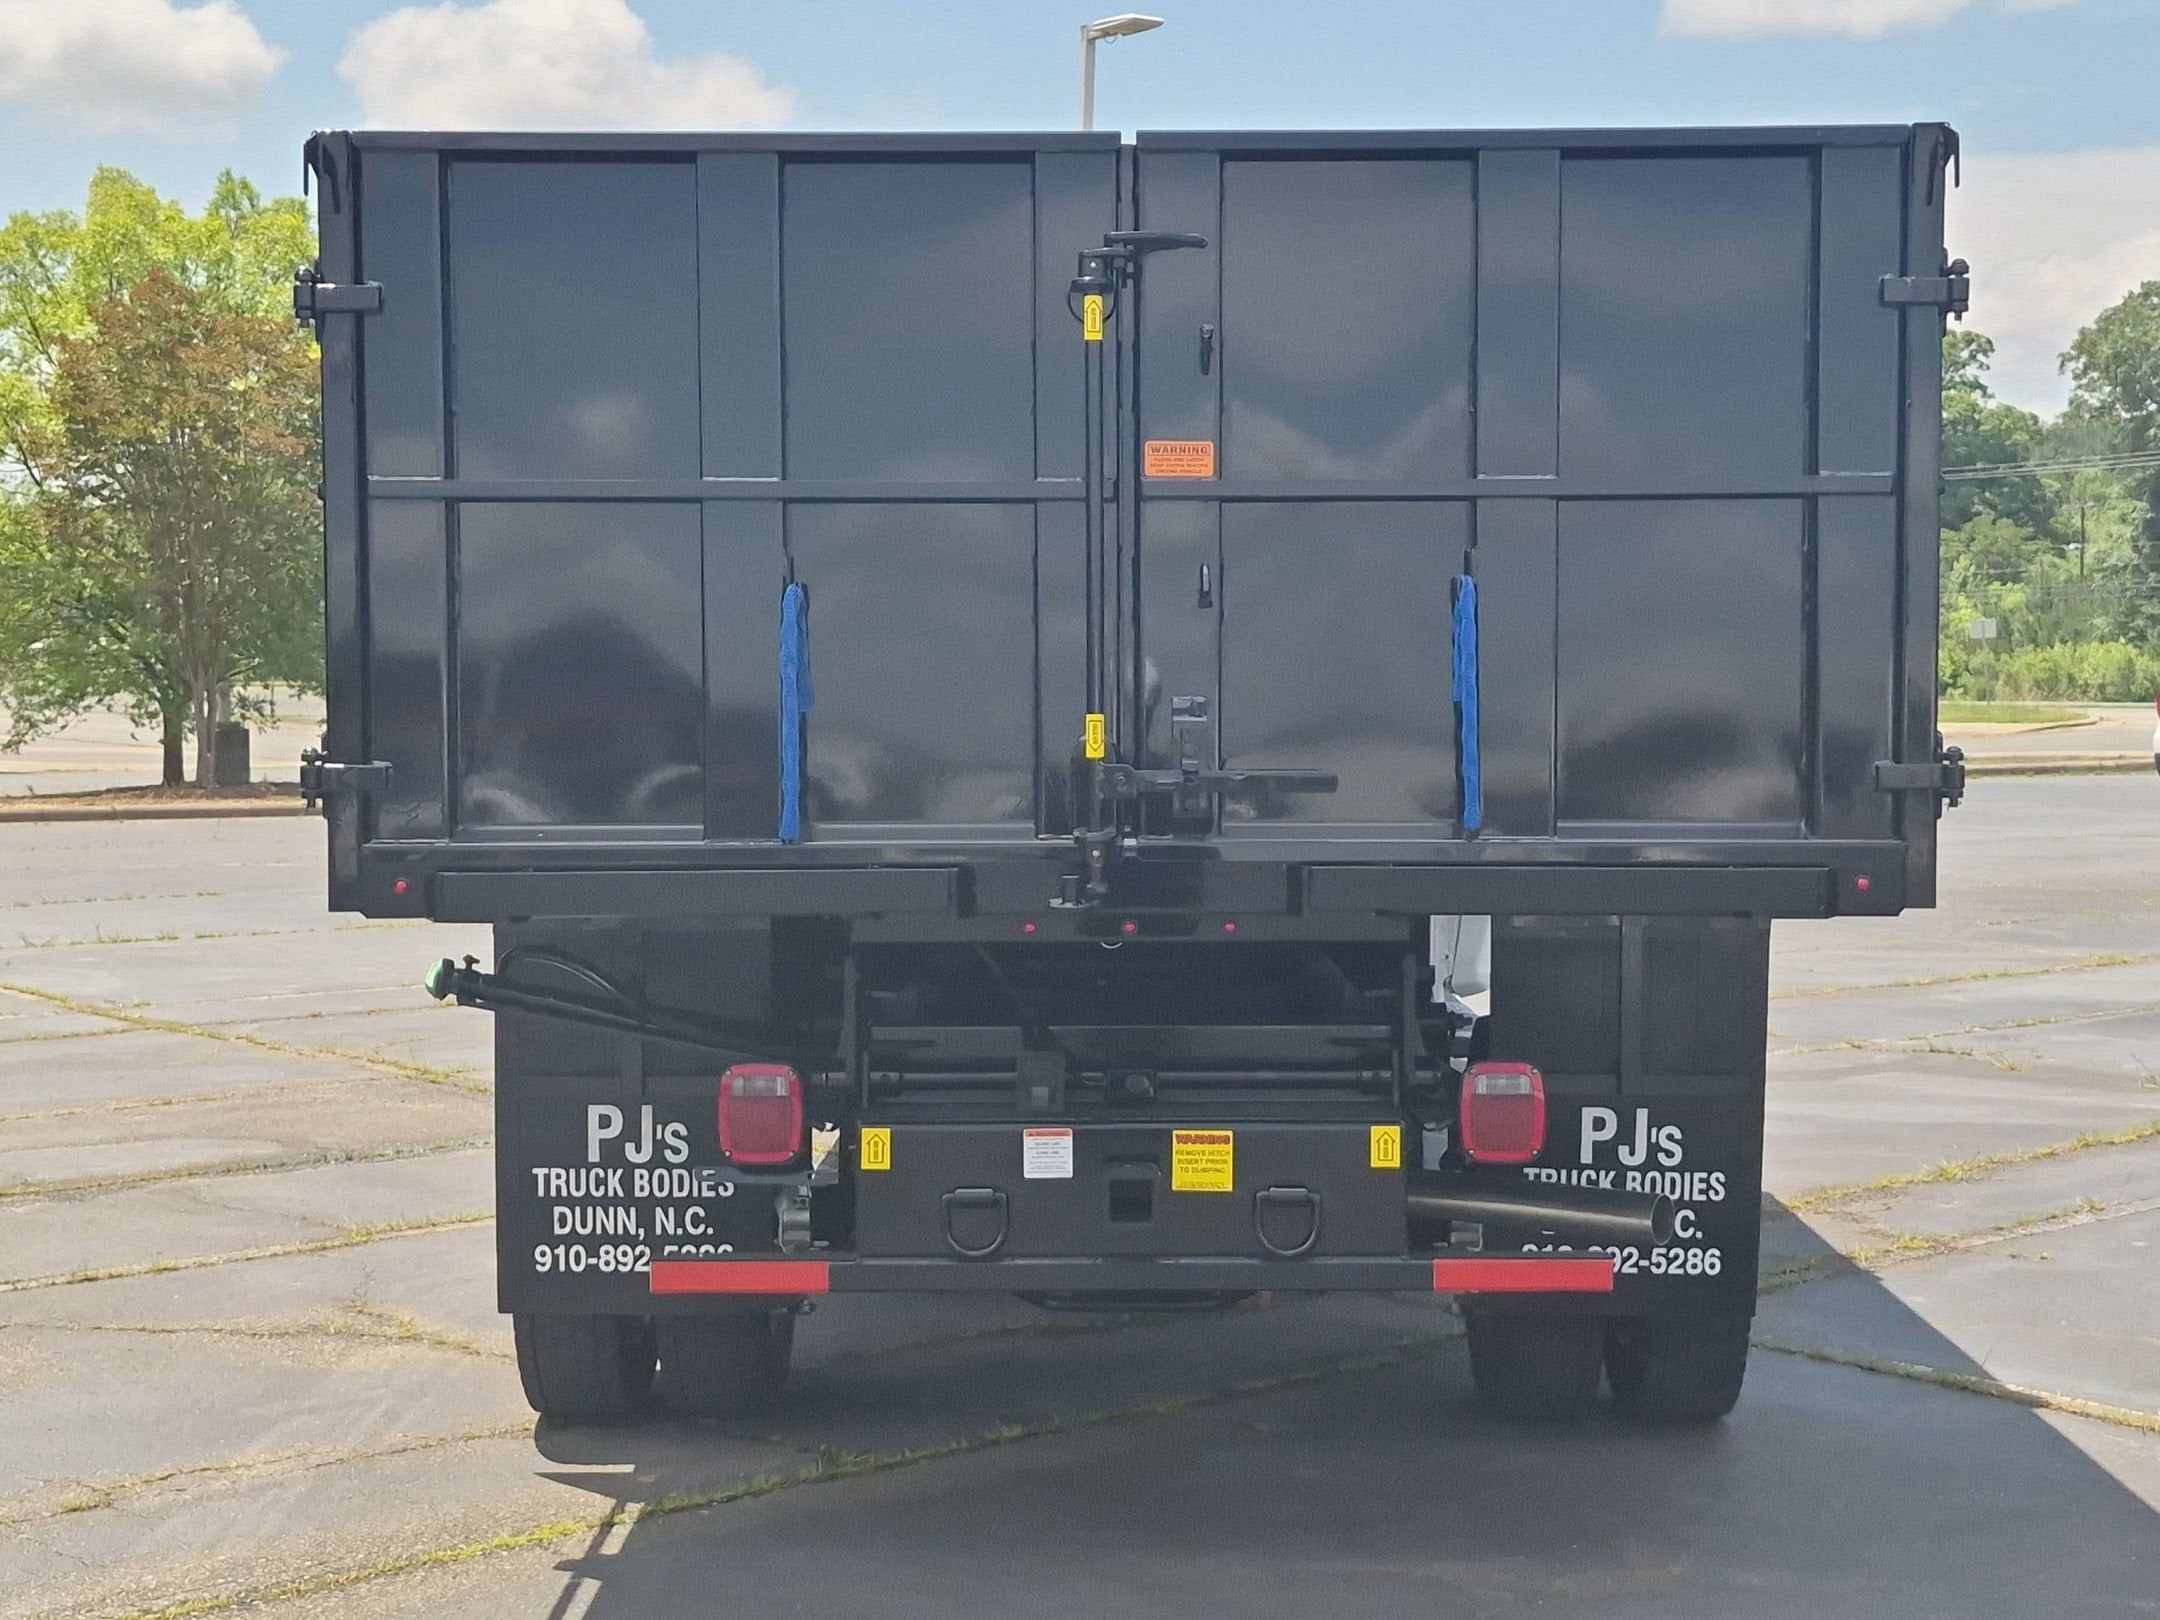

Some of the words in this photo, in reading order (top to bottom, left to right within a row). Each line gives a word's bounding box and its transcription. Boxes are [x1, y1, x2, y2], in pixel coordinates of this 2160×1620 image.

[1151, 446, 1209, 454] WARNING
[587, 1104, 690, 1164] PJ's
[1580, 1106, 1683, 1167] PJ's
[532, 1167, 624, 1198] TRUCK
[1626, 1170, 1726, 1201] BODIES
[553, 1206, 645, 1241] DUNN,
[655, 1206, 714, 1236] N.C.
